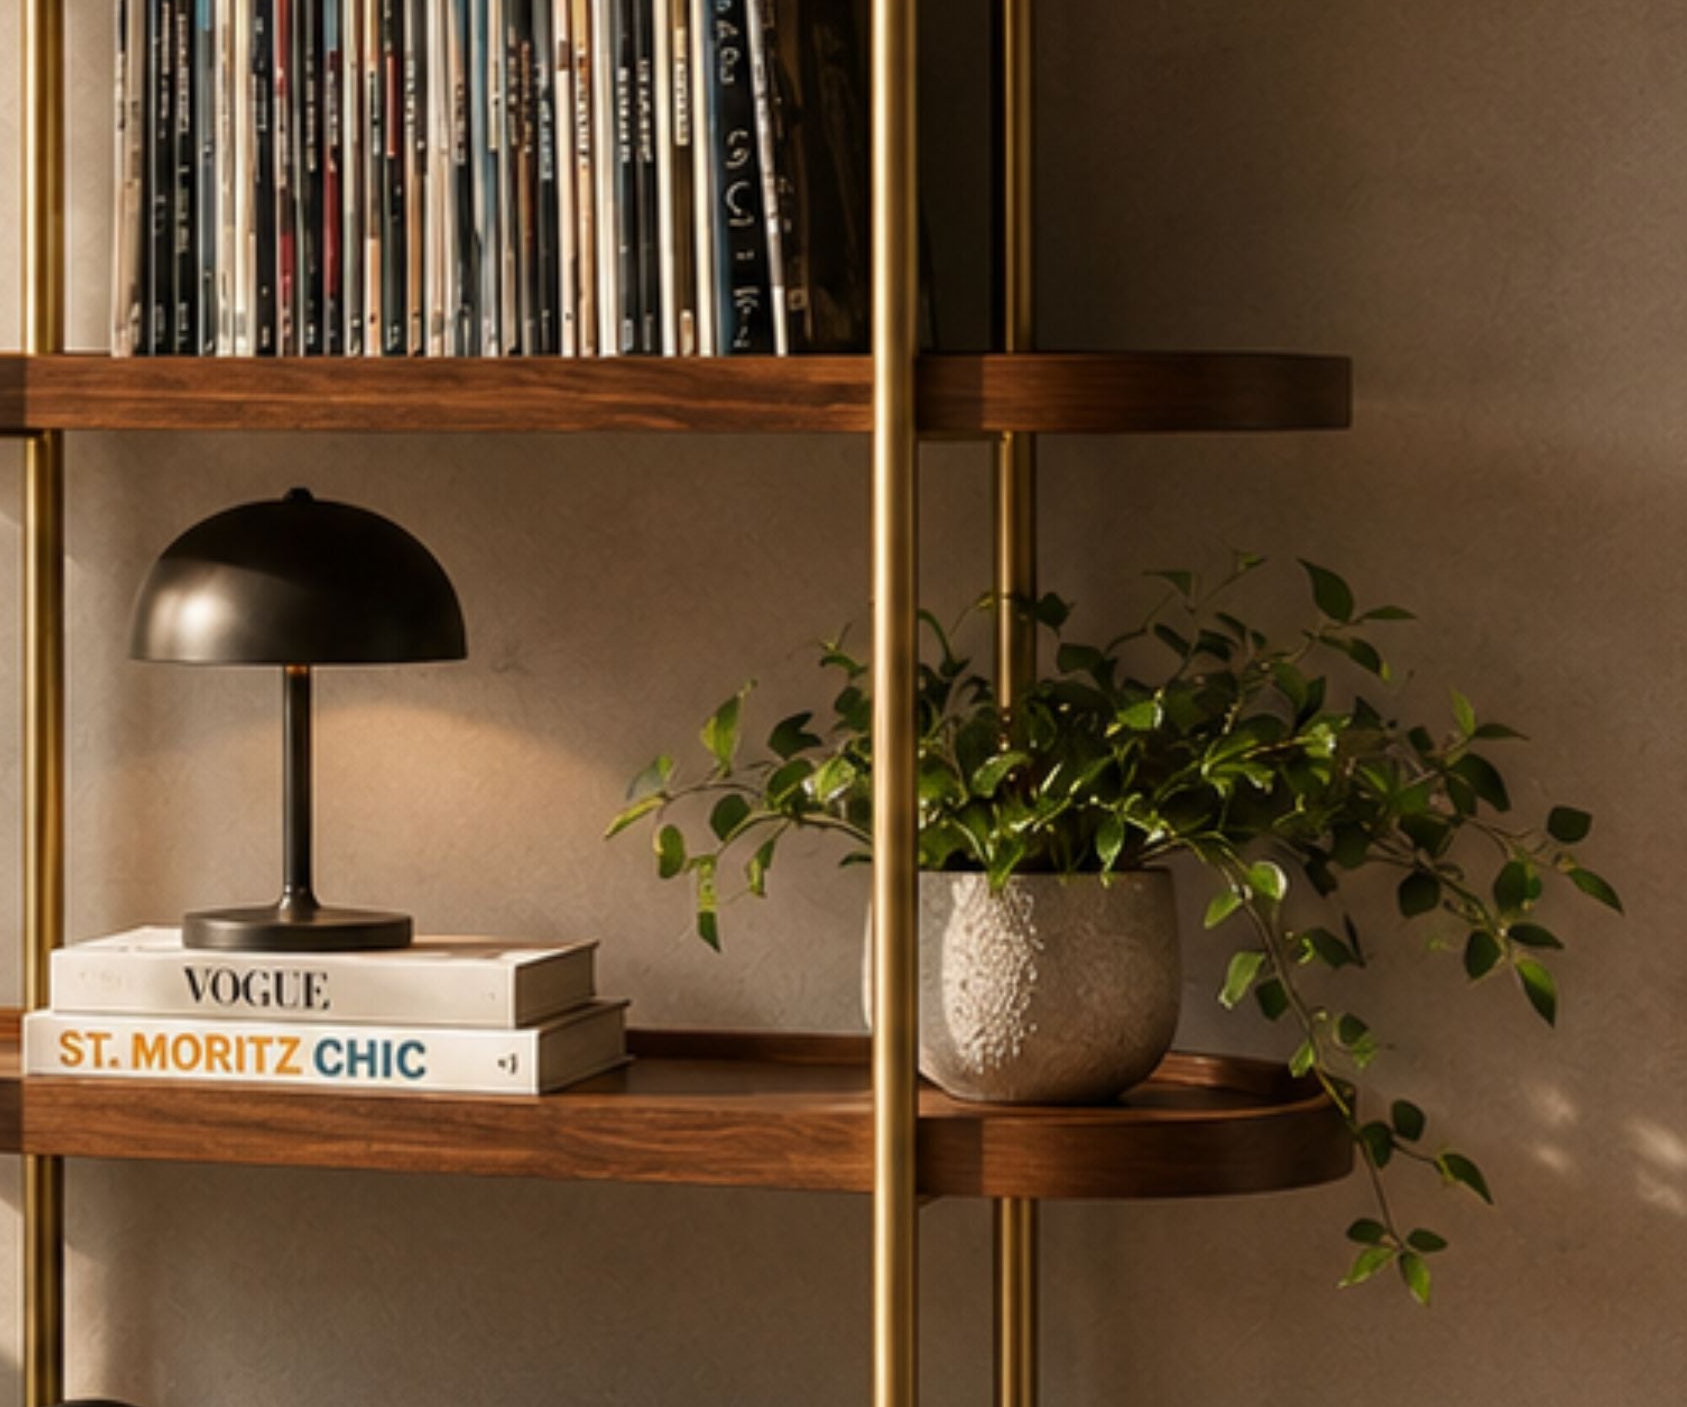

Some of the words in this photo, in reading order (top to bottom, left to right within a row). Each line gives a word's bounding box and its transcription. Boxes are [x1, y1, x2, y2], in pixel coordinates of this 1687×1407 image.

[184, 966, 330, 1011] VOGUE
[59, 1029, 120, 1068] ST.
[131, 1032, 303, 1075] MORITZ
[314, 1038, 427, 1079] CHIC
